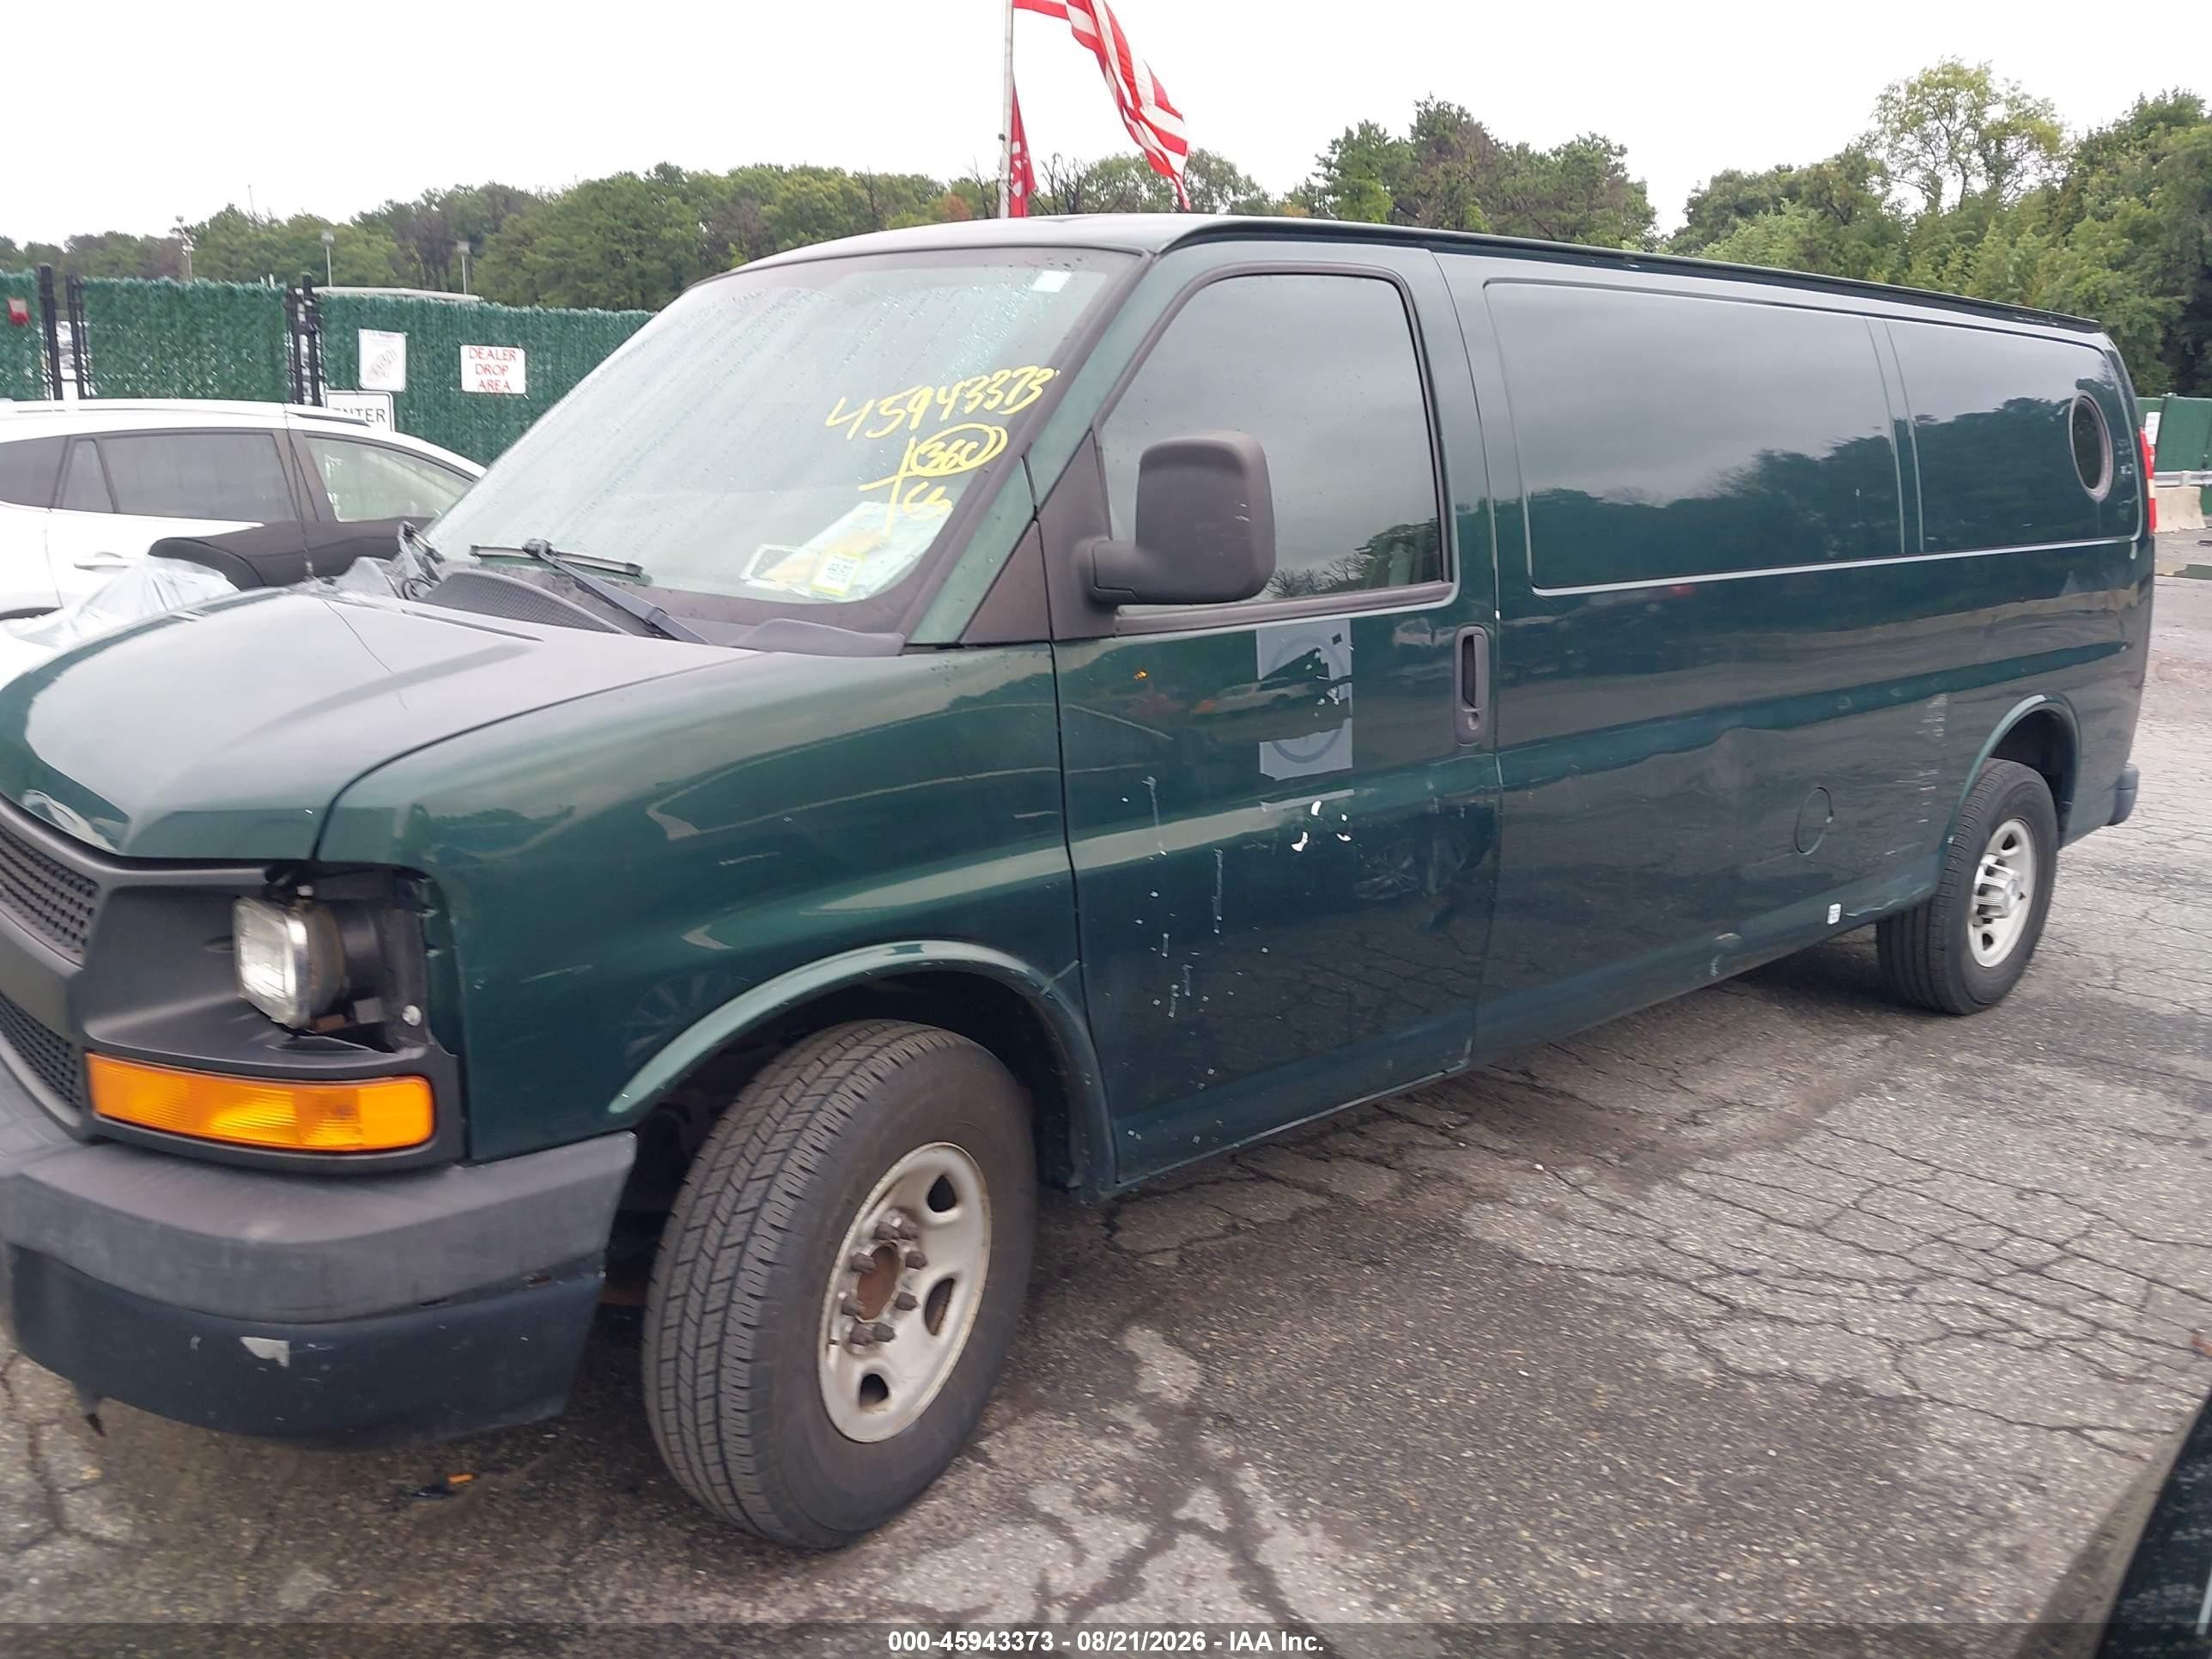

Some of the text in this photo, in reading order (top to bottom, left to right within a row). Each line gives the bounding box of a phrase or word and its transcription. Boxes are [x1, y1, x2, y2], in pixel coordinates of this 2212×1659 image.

[468, 346, 517, 362] DEALER
[475, 362, 509, 376] DROP
[477, 379, 513, 393] AREA
[825, 365, 1055, 441] 45943373
